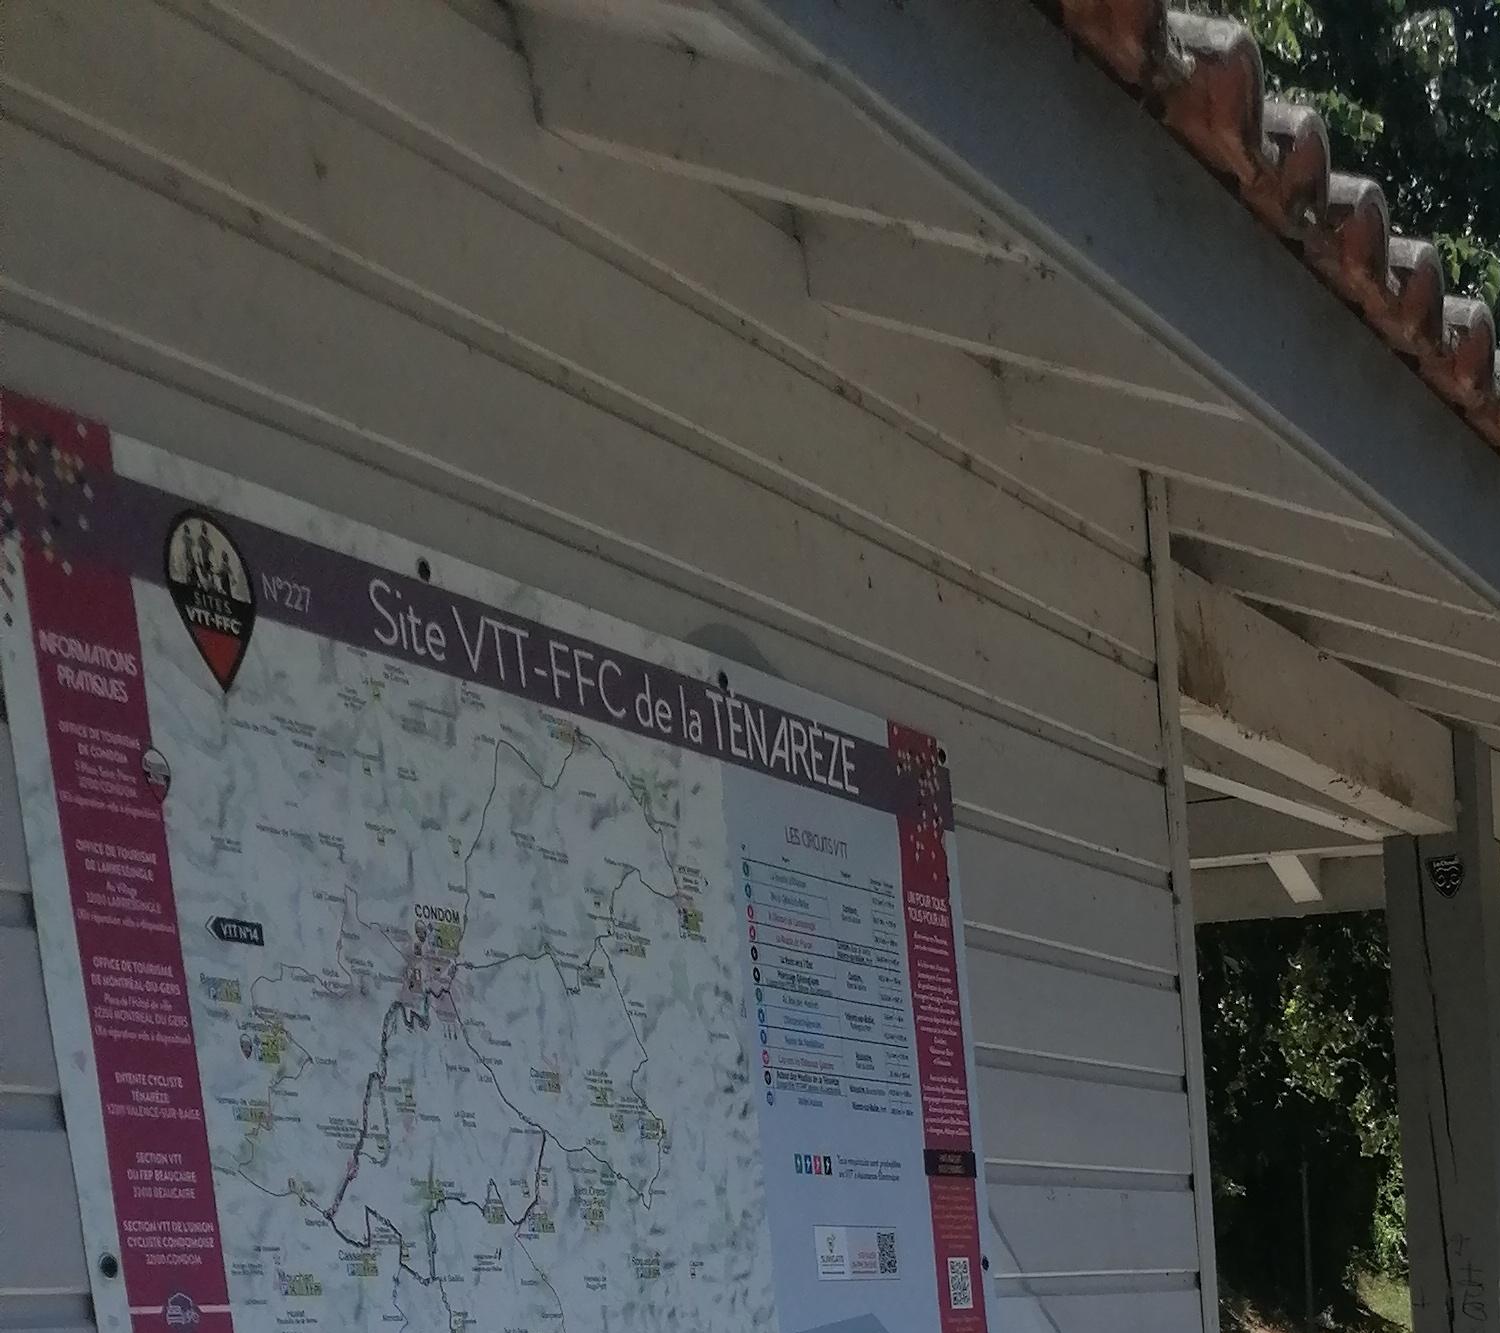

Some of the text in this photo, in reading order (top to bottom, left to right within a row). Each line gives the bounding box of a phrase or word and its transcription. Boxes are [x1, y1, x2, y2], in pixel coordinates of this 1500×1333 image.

[194, 591, 233, 615] SITES
[262, 572, 311, 617] N°227
[38, 629, 138, 677] INFORMATIONS
[368, 577, 446, 662] Site
[451, 605, 627, 720] VTT-FFC
[636, 673, 673, 735] de
[680, 685, 703, 745] la
[56, 664, 129, 703] PRATIQUES
[414, 904, 460, 923] CONDOM
[136, 1152, 167, 1165] SECTION
[123, 1220, 157, 1232] SECTION
[127, 1237, 162, 1248] CYCLISTE
